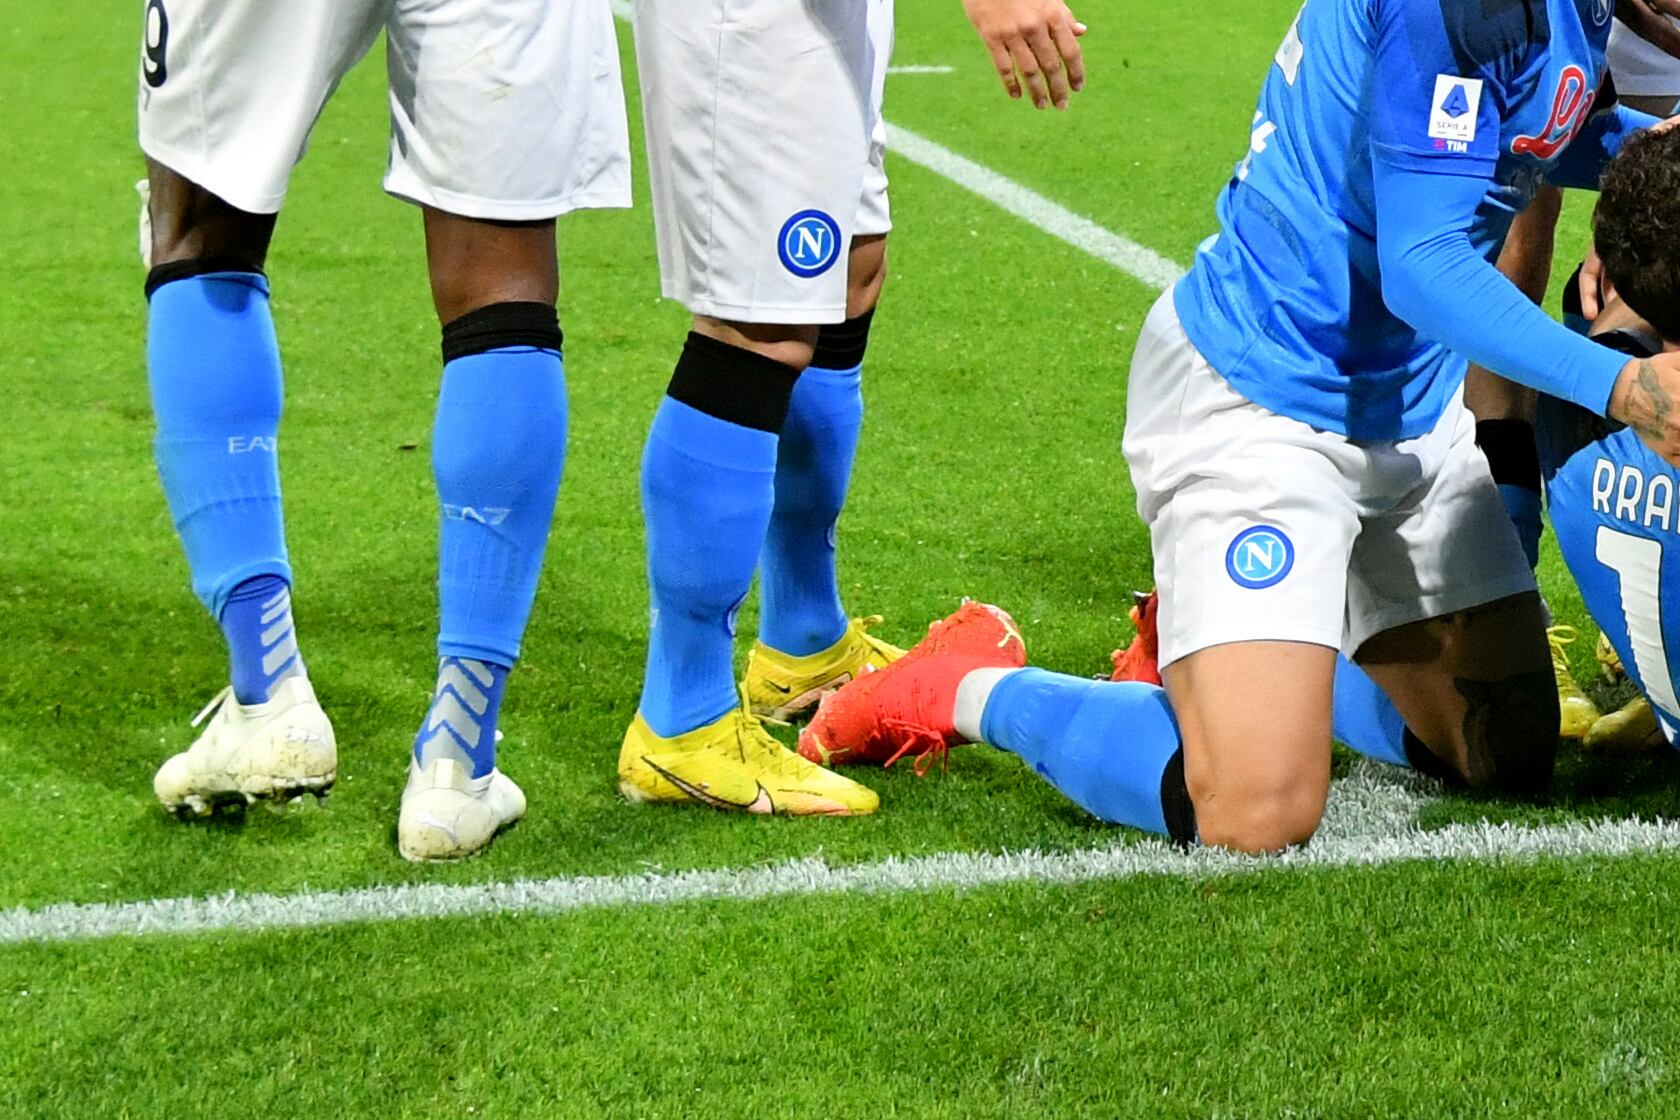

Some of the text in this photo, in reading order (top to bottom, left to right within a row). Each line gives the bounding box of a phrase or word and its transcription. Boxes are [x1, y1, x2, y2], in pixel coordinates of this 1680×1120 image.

[1446, 140, 1468, 153] TIM
[795, 226, 825, 259] N
[1244, 540, 1276, 572] N
